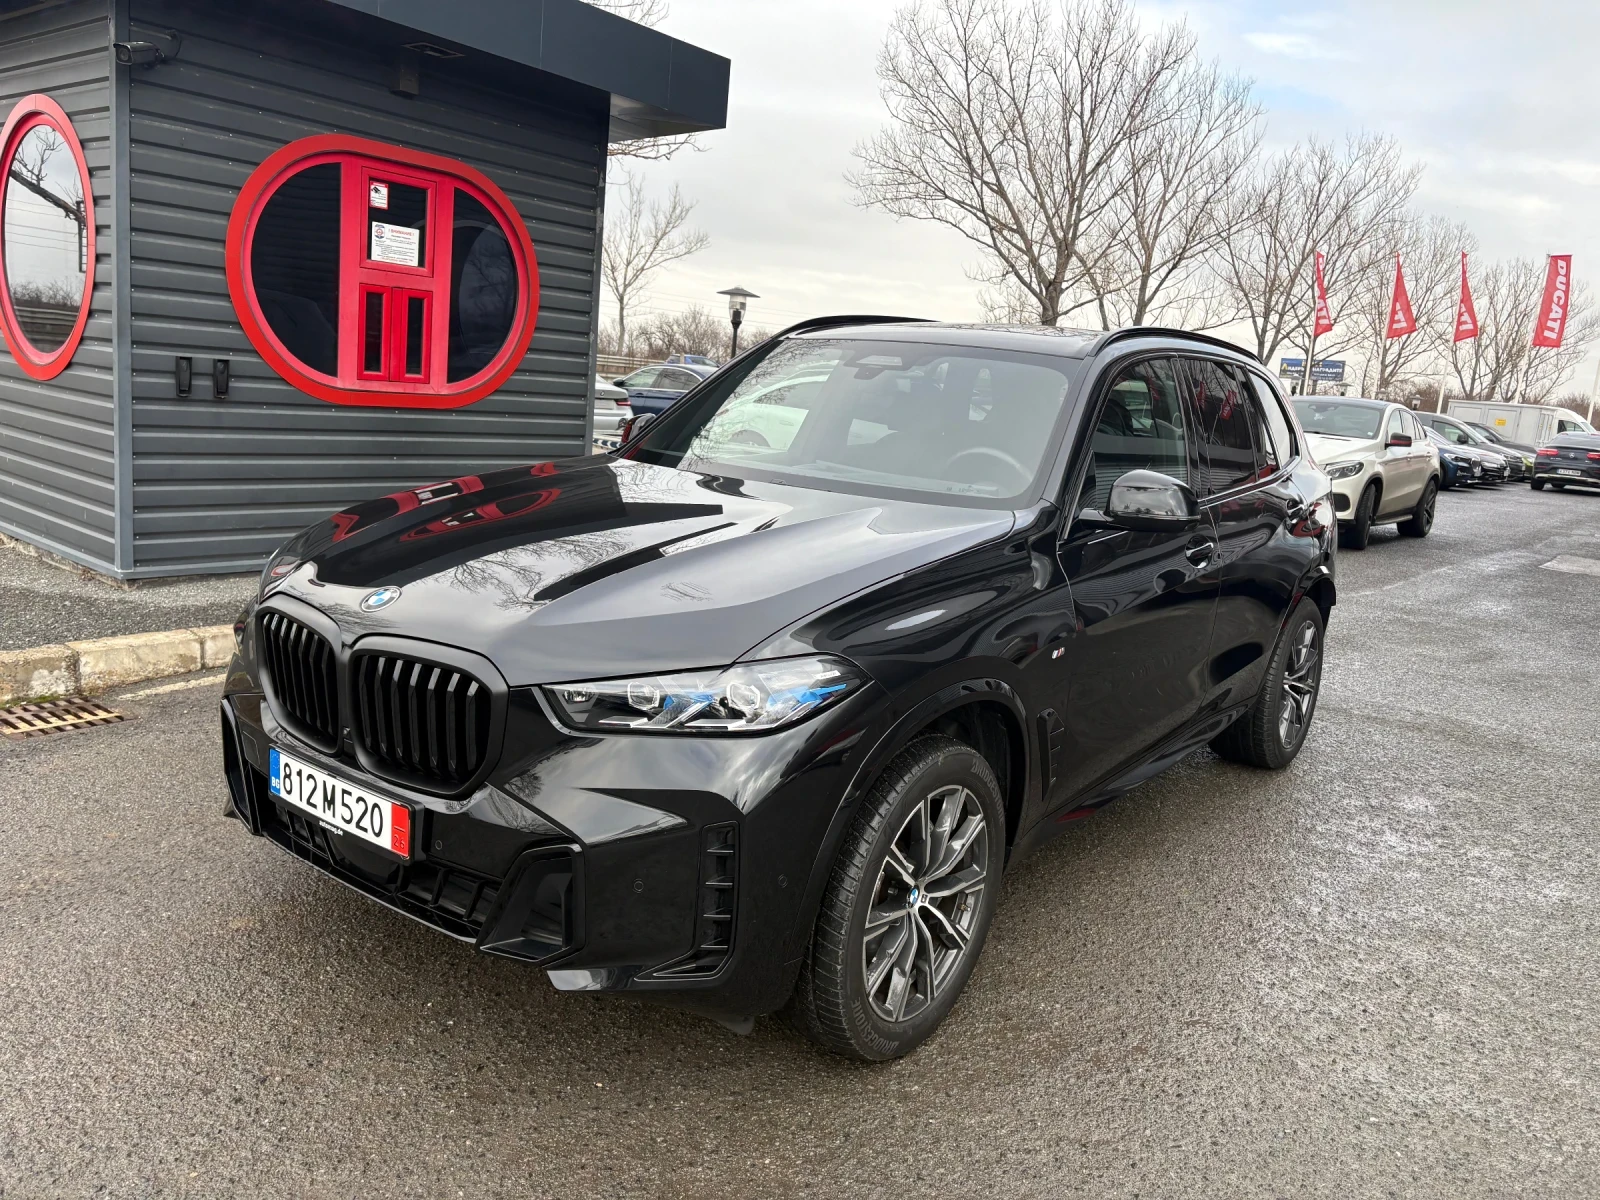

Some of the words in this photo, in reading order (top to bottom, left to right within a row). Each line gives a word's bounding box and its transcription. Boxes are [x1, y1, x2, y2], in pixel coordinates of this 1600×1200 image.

[1543, 259, 1567, 340] DUCATI
[271, 776, 280, 789] BG
[282, 762, 384, 838] 812M520
[394, 834, 405, 850] 26
[850, 997, 900, 1056] BRIDGESTONE
